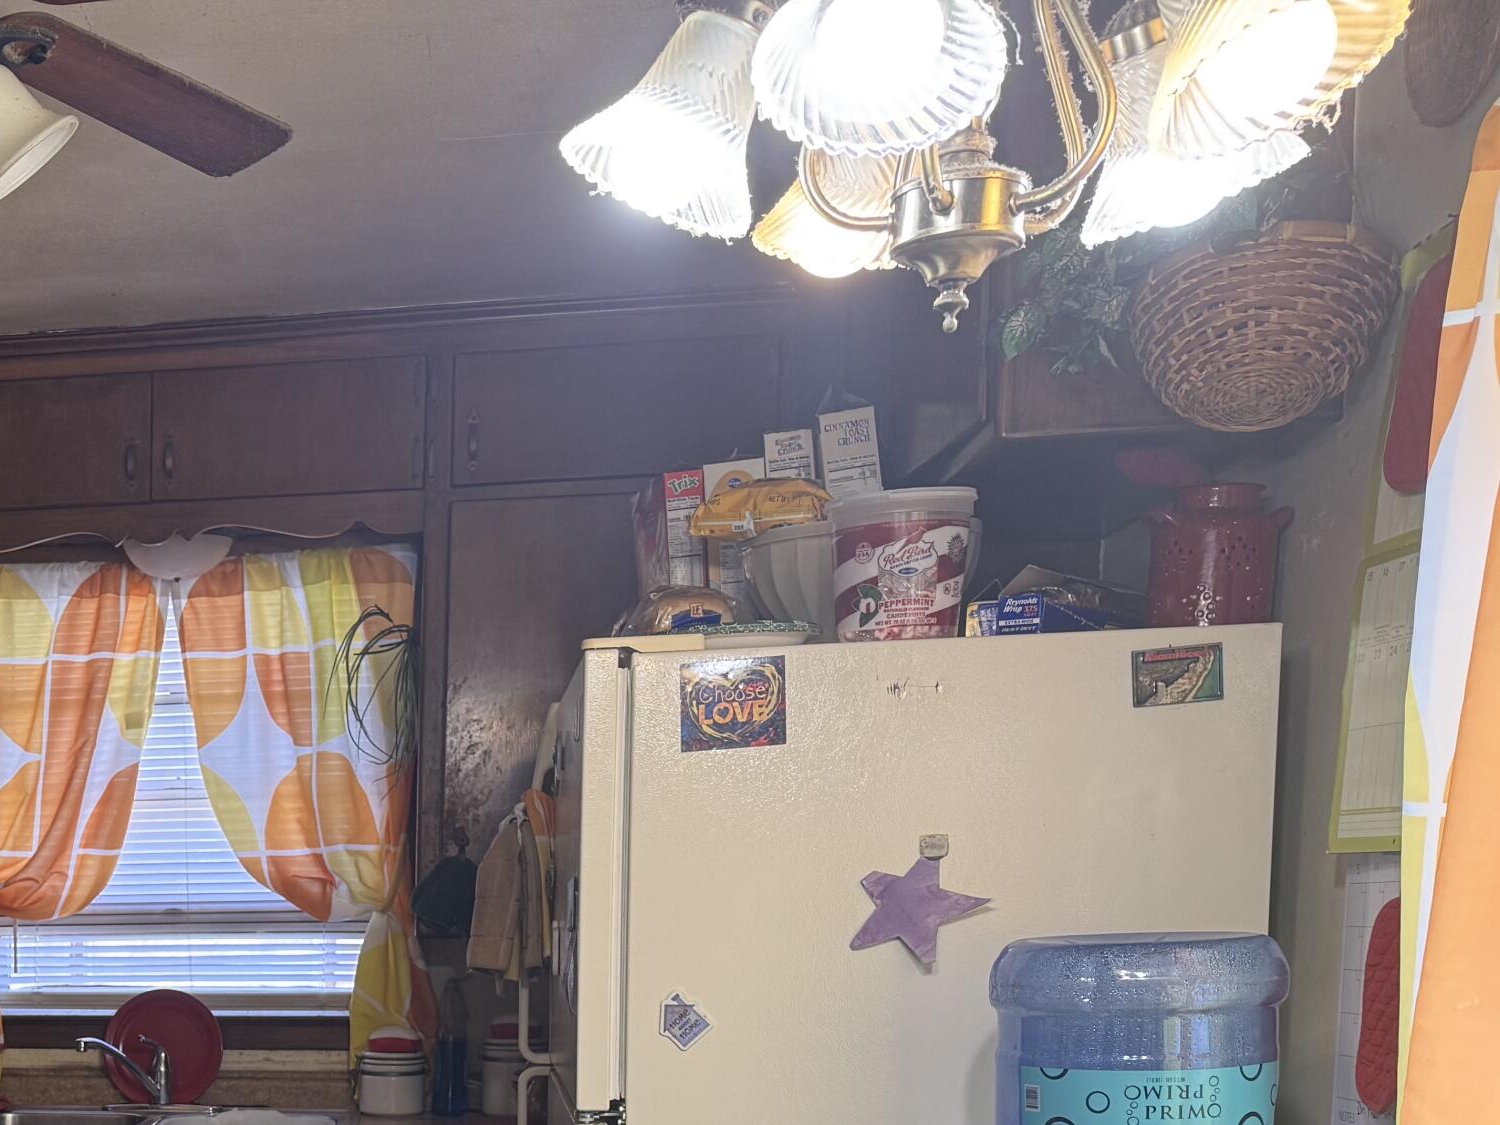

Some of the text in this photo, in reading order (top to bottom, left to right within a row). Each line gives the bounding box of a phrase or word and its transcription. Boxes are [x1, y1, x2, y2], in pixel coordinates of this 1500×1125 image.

[824, 418, 869, 432] CINNAMON
[837, 435, 870, 446] CRUNCH
[668, 474, 699, 495] Trix
[883, 549, 907, 568] Red
[906, 542, 933, 559] Bird
[878, 599, 934, 609] PEPPERMINT
[1003, 605, 1022, 613] Wrap
[1006, 597, 1038, 606] Reynolds
[699, 683, 767, 703] Choose
[698, 700, 770, 725] LOVE
[1124, 1084, 1204, 1101] PRIMO
[1145, 1103, 1222, 1120] PRIMO
